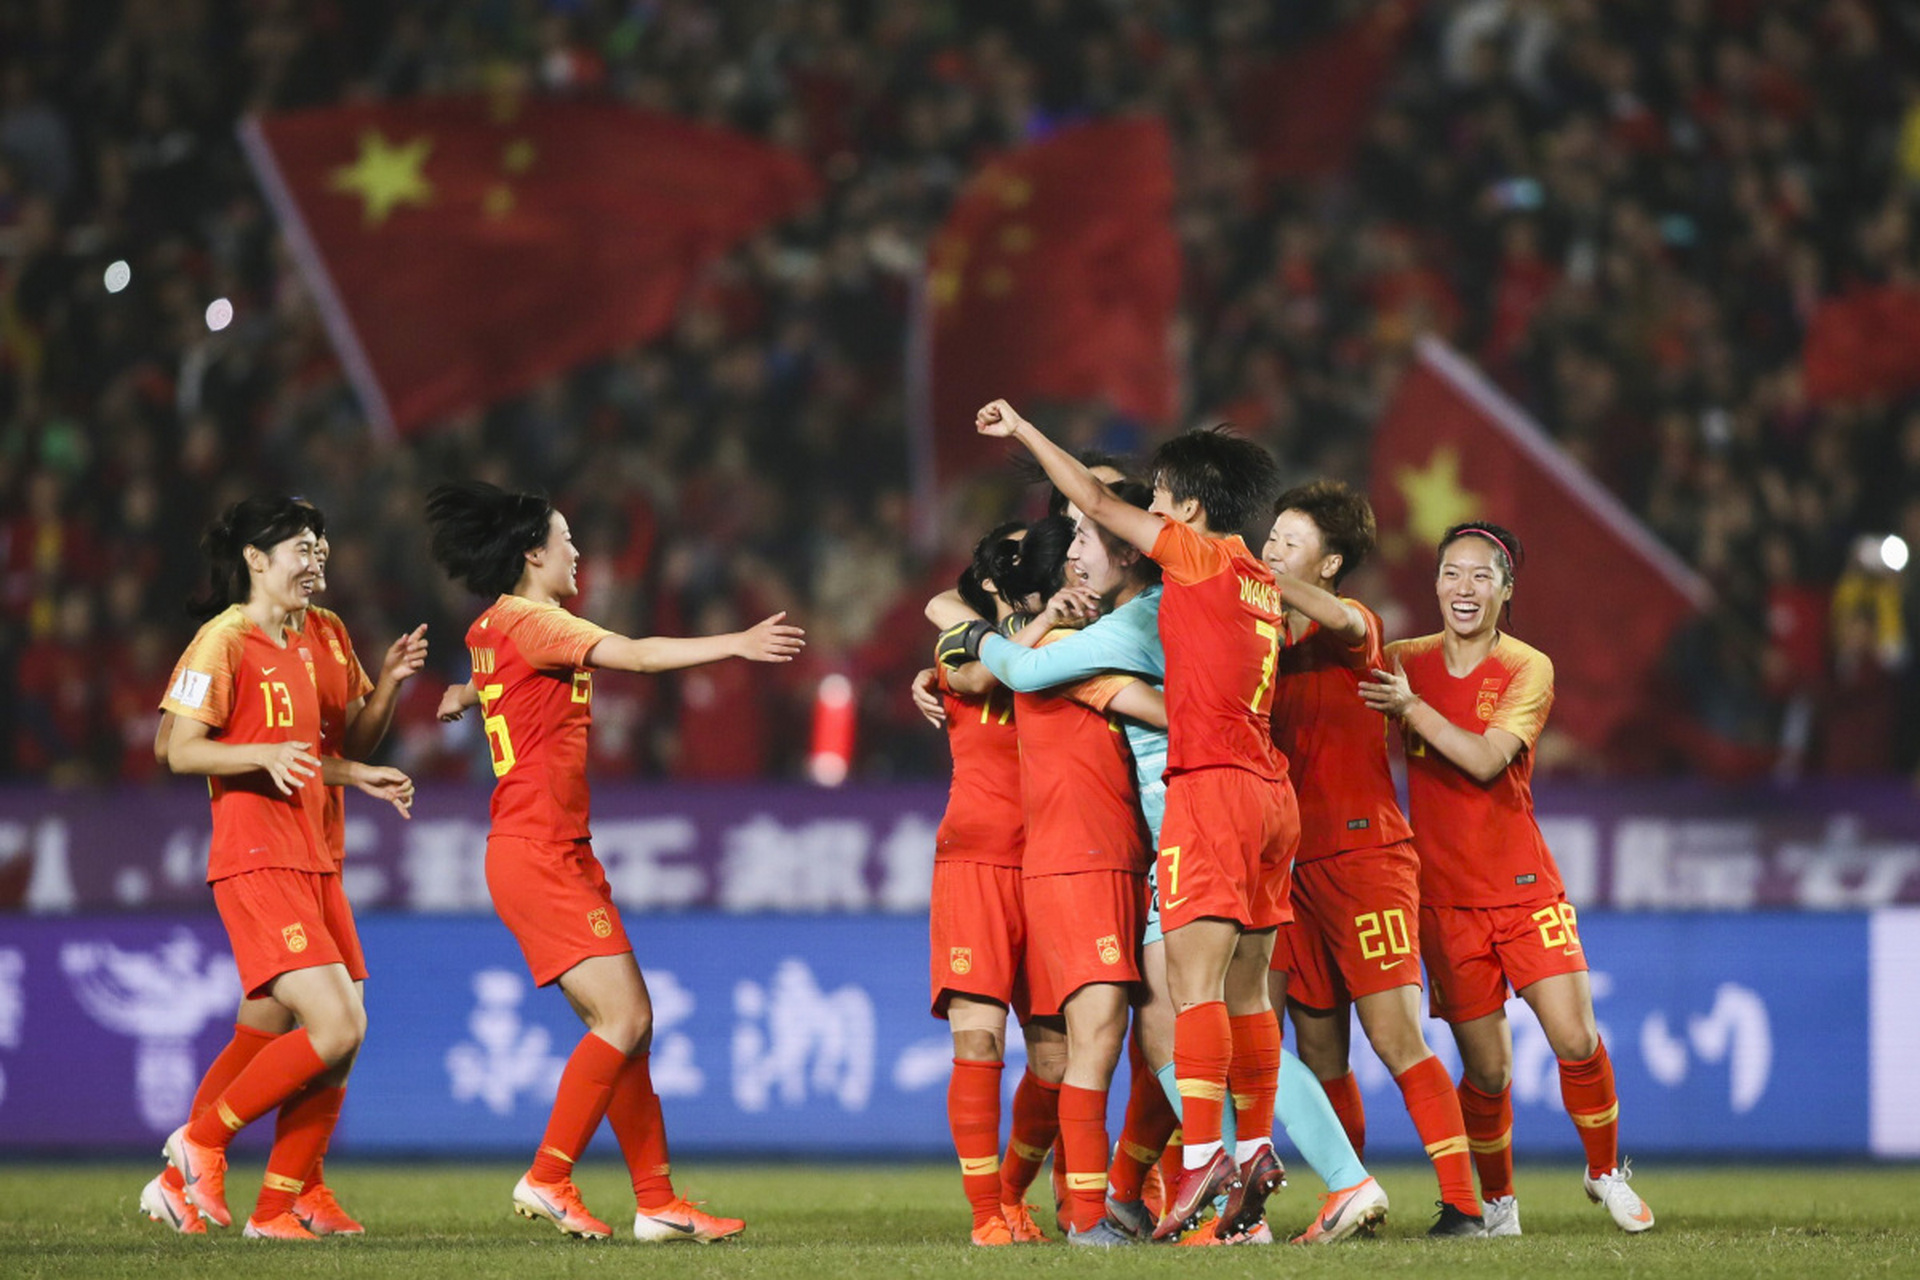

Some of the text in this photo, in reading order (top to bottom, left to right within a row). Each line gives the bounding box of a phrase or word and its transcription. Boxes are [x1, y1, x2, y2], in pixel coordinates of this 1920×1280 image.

[1250, 618, 1277, 713] 7
[260, 682, 294, 727] 13
[1161, 846, 1180, 895] 7
[1355, 908, 1411, 960] 20
[1531, 902, 1581, 948] 28
